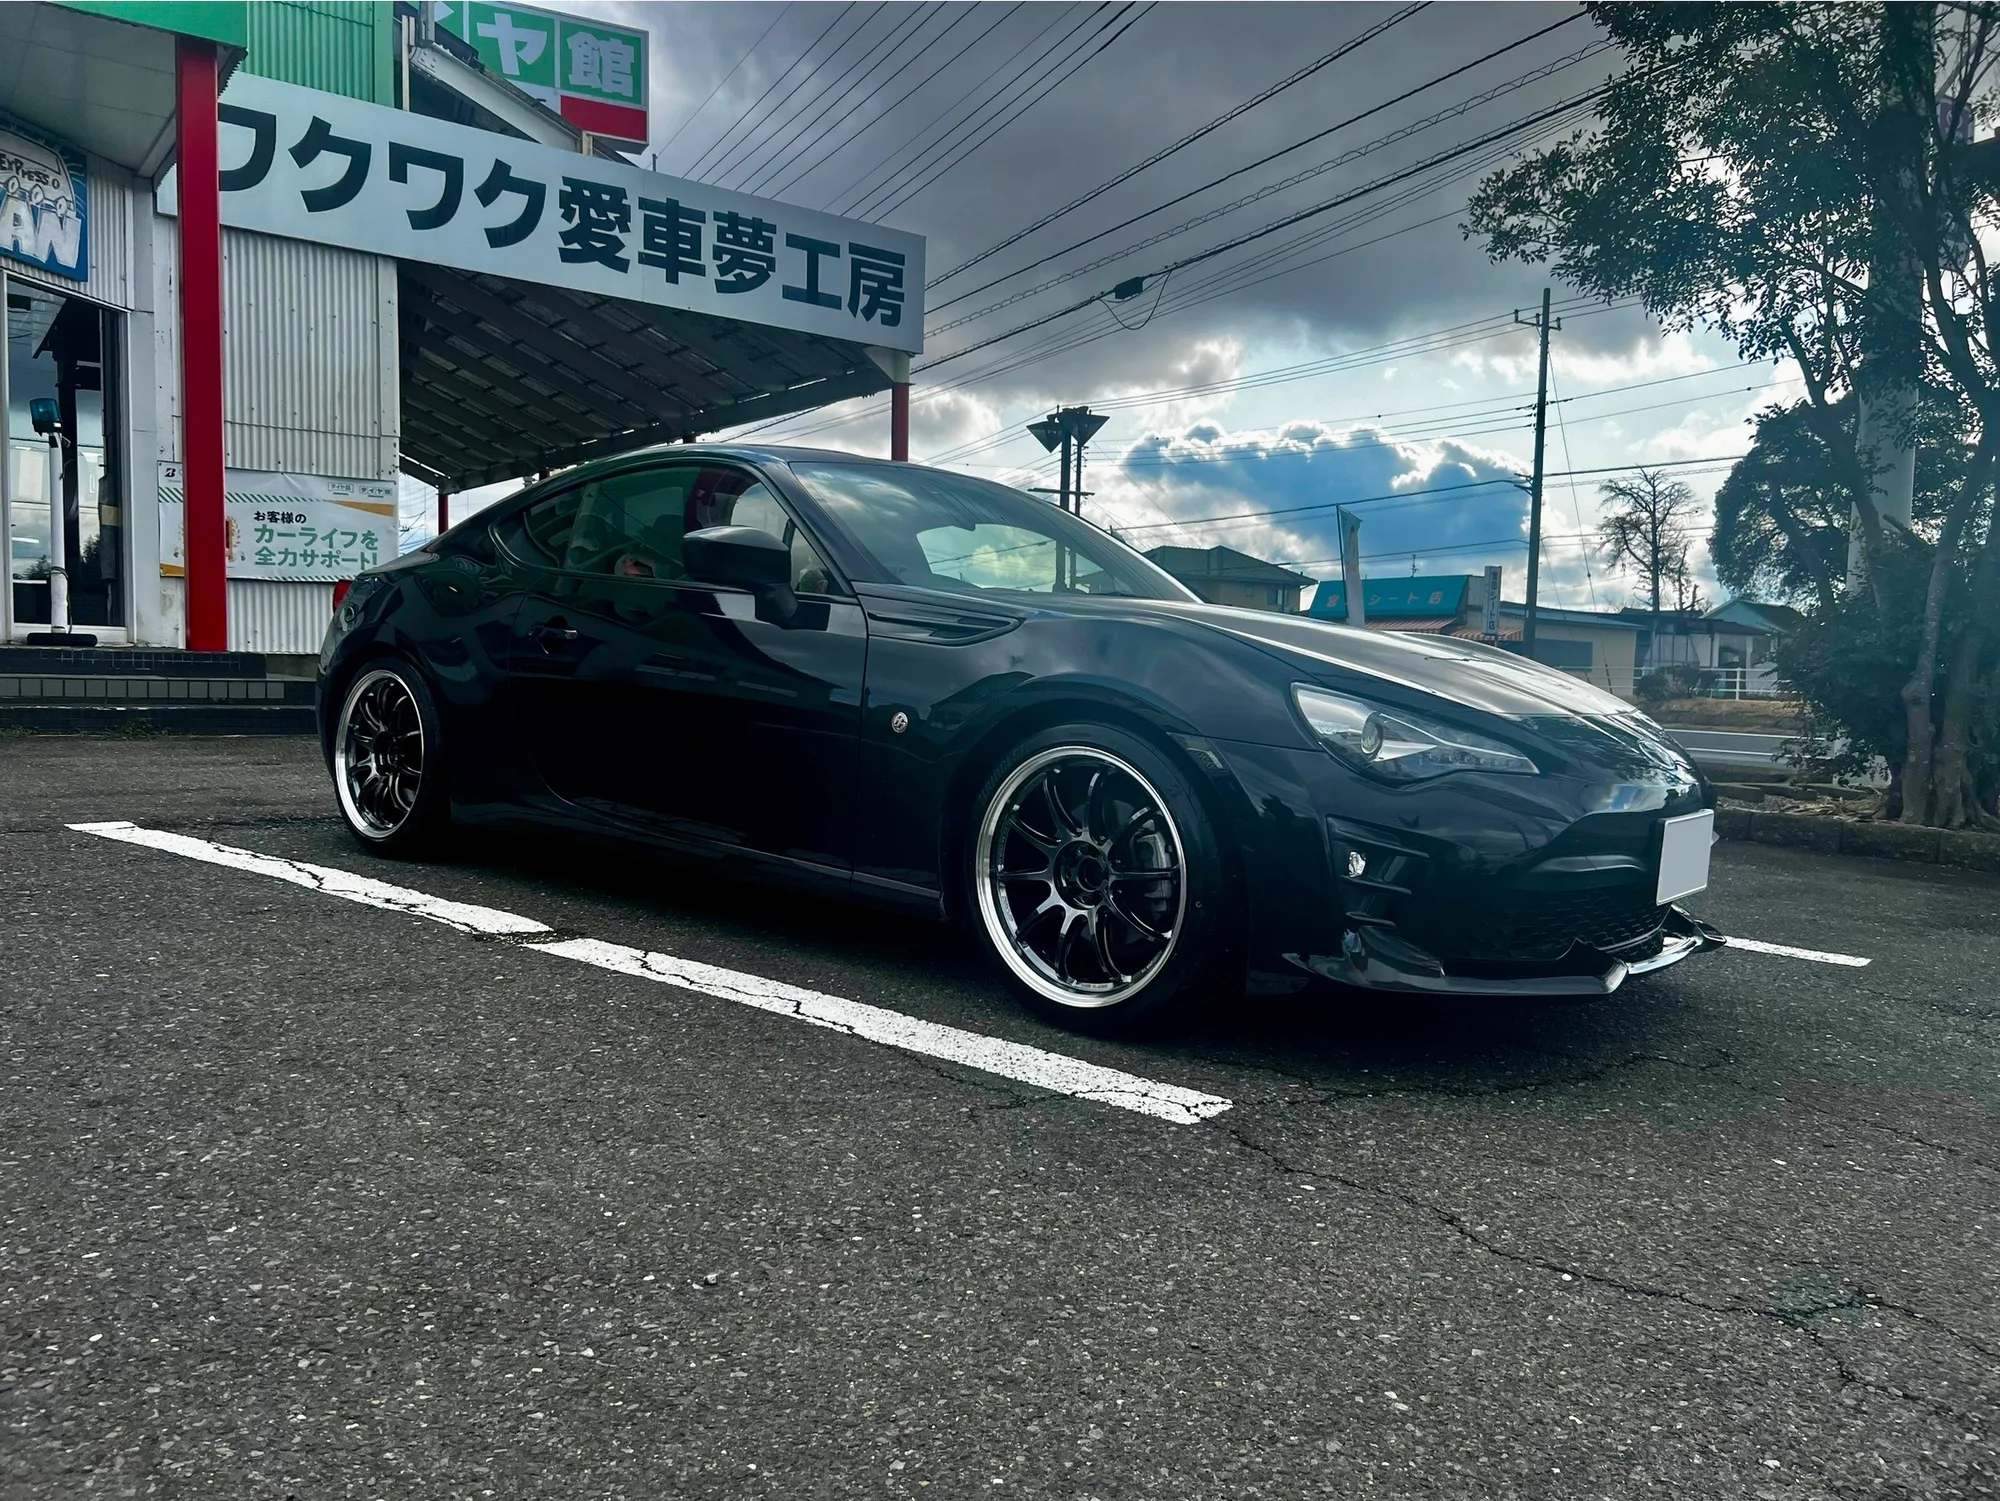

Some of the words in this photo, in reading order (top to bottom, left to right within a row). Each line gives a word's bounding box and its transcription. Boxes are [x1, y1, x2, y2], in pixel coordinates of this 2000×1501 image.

[434, 2, 635, 97] ヤ館
[254, 511, 307, 524] お客様の
[254, 524, 379, 551] カーライフを
